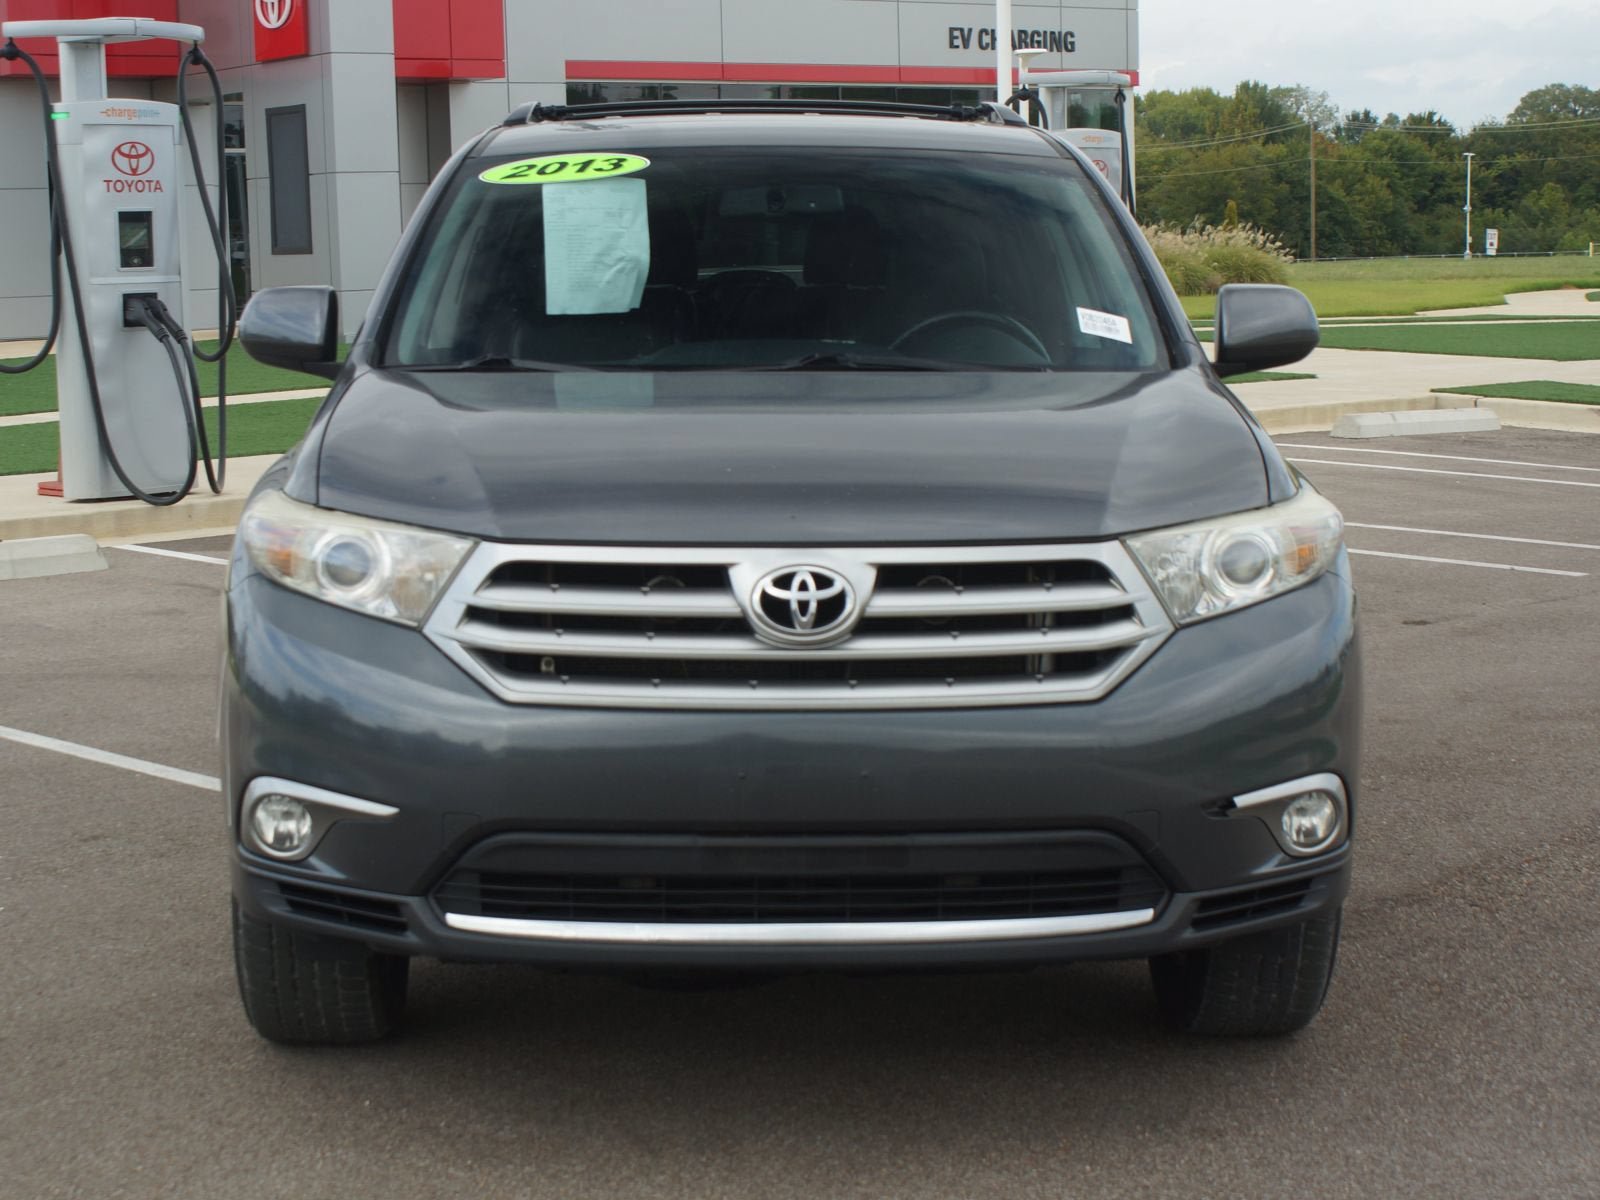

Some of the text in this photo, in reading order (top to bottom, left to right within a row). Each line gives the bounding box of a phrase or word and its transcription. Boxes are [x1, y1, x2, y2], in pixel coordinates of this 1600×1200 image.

[948, 27, 973, 50] EV
[500, 157, 627, 180] 2013
[103, 179, 163, 193] TOYOTA
